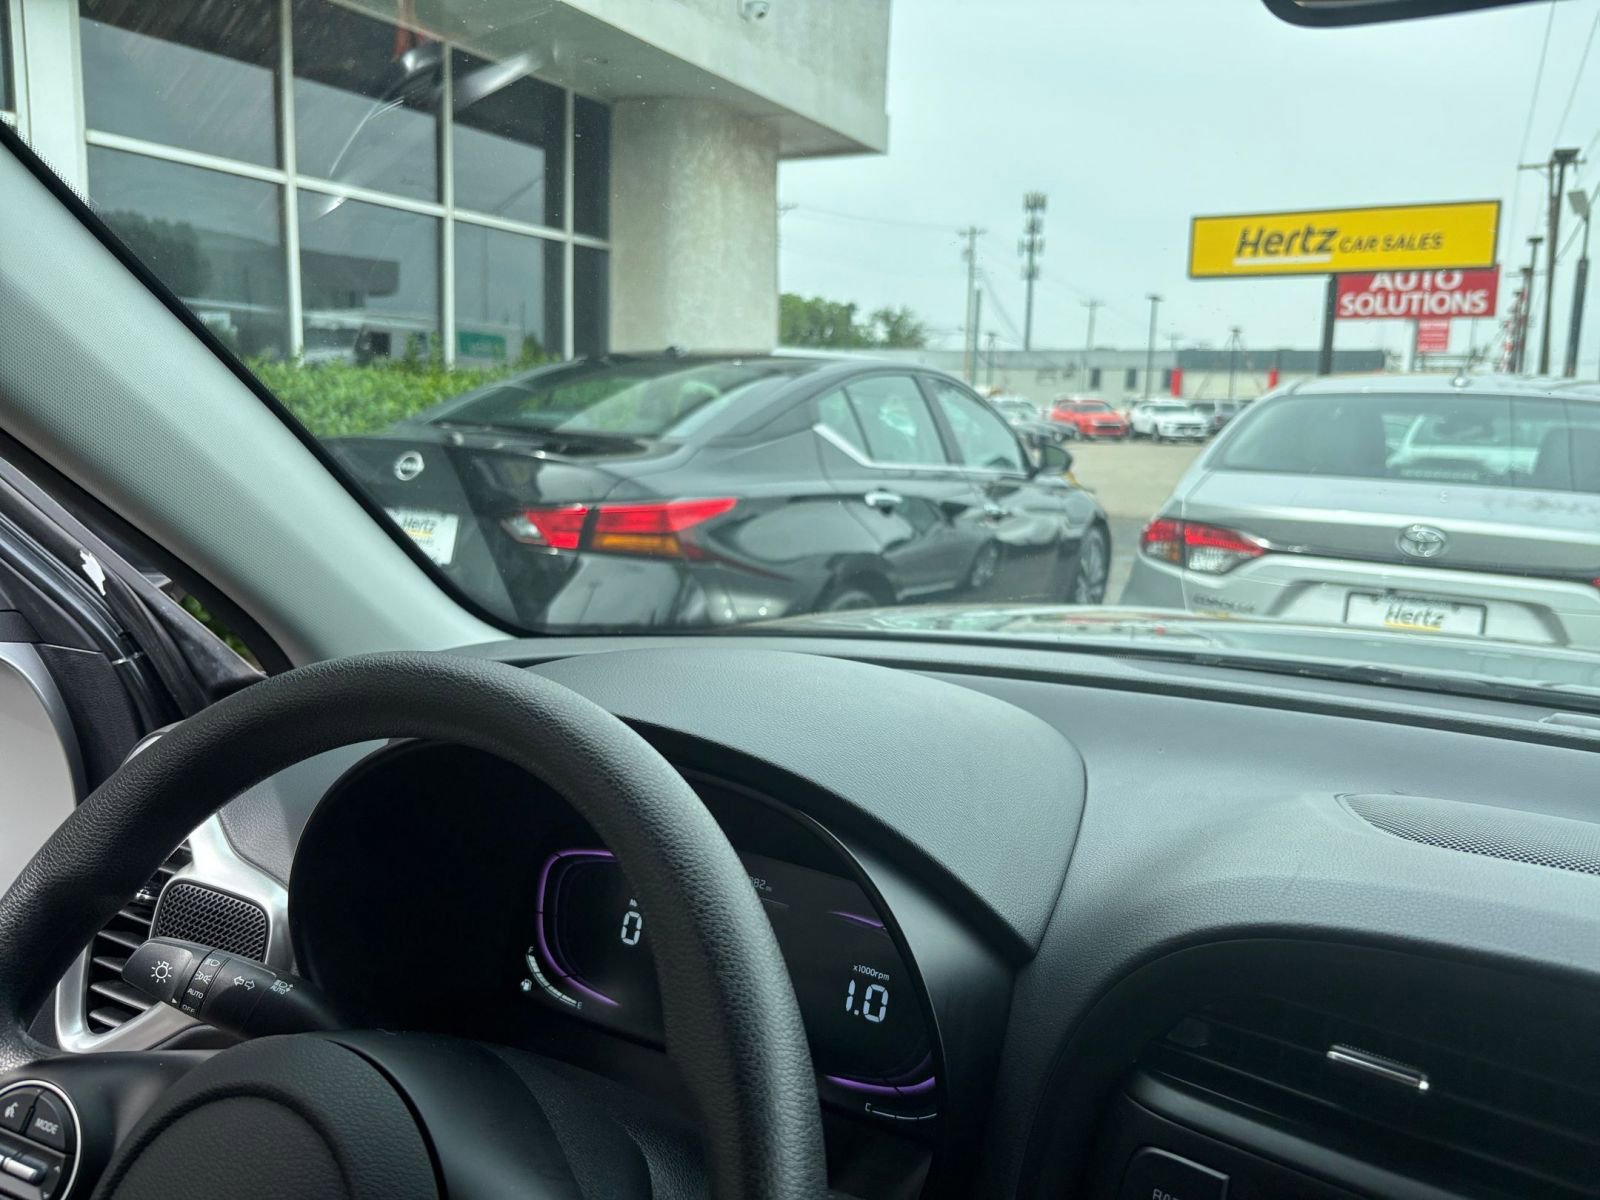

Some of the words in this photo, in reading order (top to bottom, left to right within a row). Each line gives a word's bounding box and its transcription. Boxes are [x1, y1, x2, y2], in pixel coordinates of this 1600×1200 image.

[1235, 224, 1337, 256] Hertz
[1339, 235, 1378, 253] CAR
[1381, 231, 1444, 252] SALES
[1369, 271, 1464, 292] AUTO
[1339, 289, 1489, 316] SOLUTIONS
[1384, 602, 1444, 627] Hertz
[620, 911, 642, 945] 0
[852, 964, 890, 981] x1000rpm
[187, 987, 204, 999] AUTO
[269, 985, 286, 995] AUTO
[845, 979, 889, 1022] 1.0
[181, 1003, 195, 1013] OFF
[34, 1117, 59, 1135] MODE
